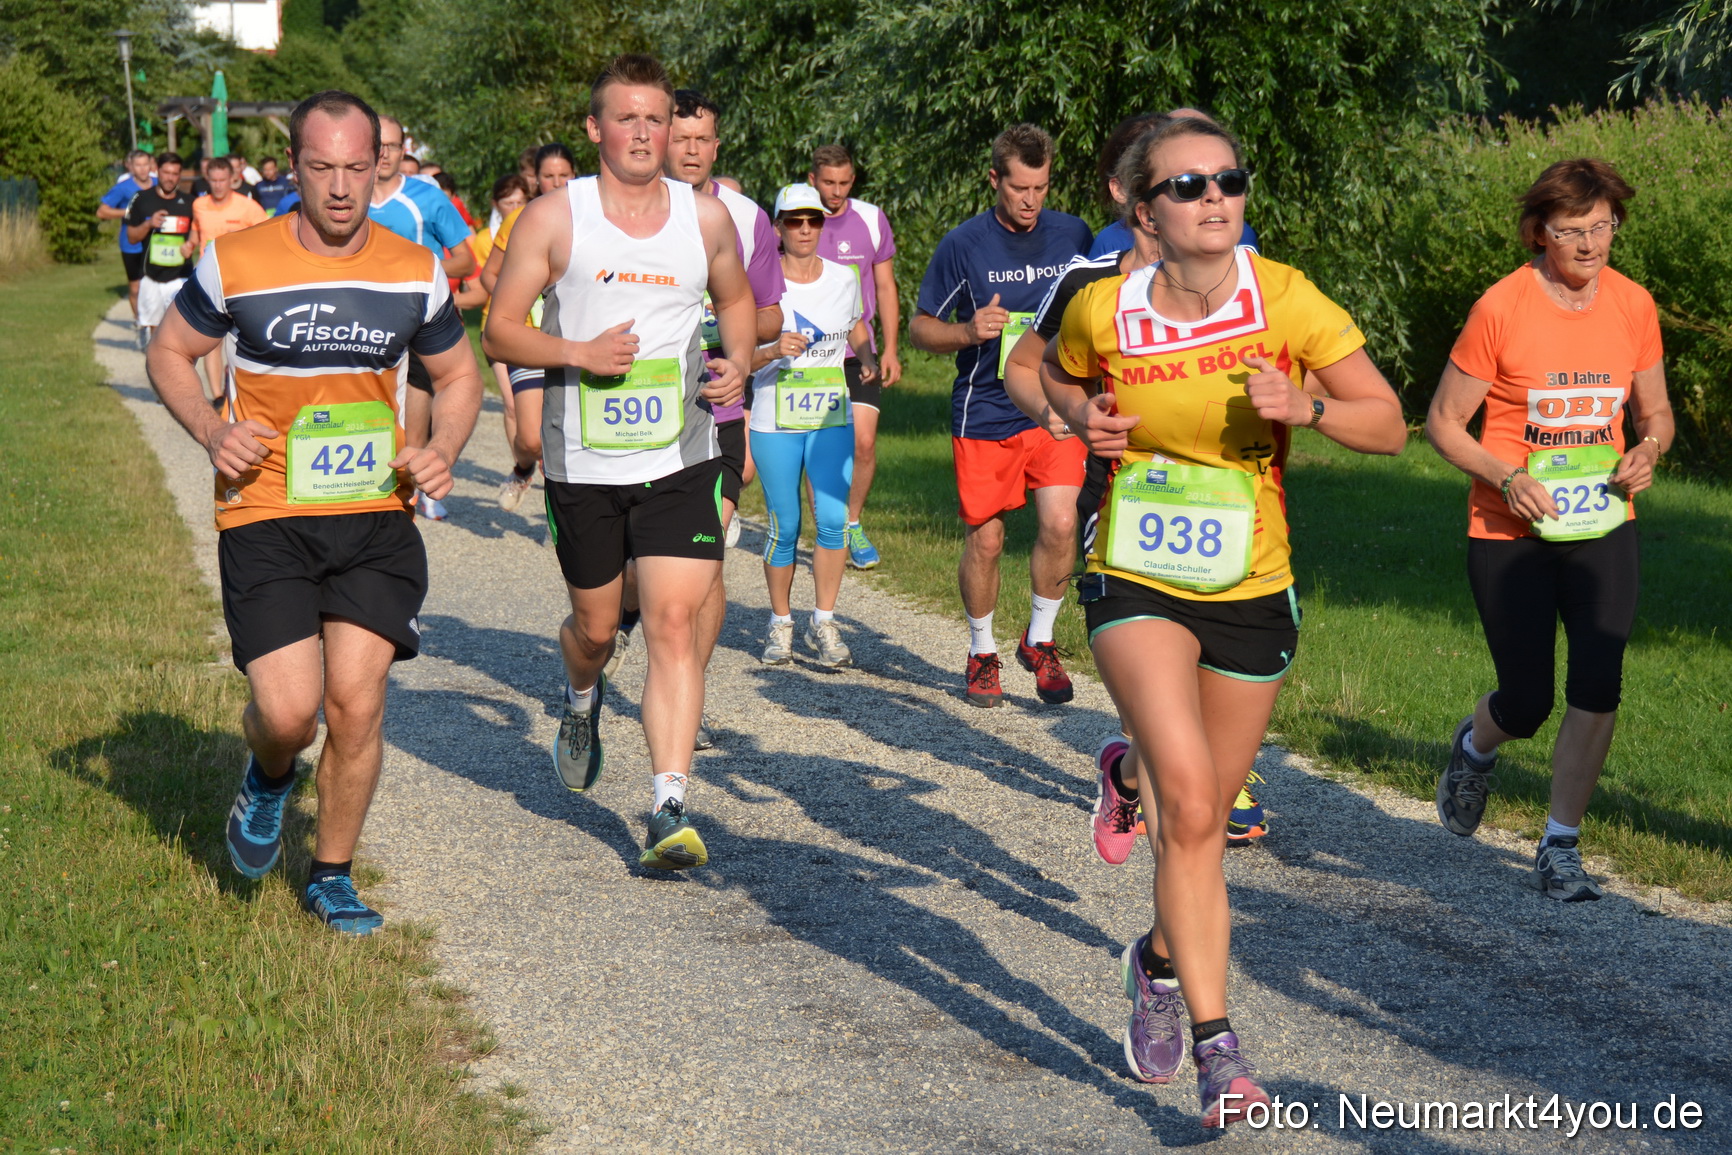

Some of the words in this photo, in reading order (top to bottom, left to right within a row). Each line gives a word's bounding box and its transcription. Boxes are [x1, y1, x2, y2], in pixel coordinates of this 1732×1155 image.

[161, 248, 176, 257] 44
[618, 272, 680, 287] KLEBL
[988, 269, 1024, 283] EURO
[290, 321, 396, 345] Fischer
[301, 343, 387, 356] AUTOMOBILE
[806, 347, 837, 358] Team
[1121, 360, 1190, 386] MAX
[1197, 342, 1274, 376] BÖGL
[1546, 372, 1569, 386] 30
[1572, 371, 1611, 385] Jahre
[785, 392, 840, 412] 1475
[1537, 396, 1618, 419] OBI
[603, 395, 663, 425] 590
[306, 420, 345, 430] firmenlauf
[1523, 423, 1615, 446] Neumarkt
[310, 441, 377, 476] 424
[312, 482, 343, 490] Benedikt
[343, 480, 376, 488] Heiselbetz
[1136, 481, 1186, 495] firmenlauf
[1552, 482, 1610, 516] 623
[1565, 520, 1581, 528] Anna
[1138, 512, 1223, 558] 938
[1143, 560, 1175, 571] Claudia
